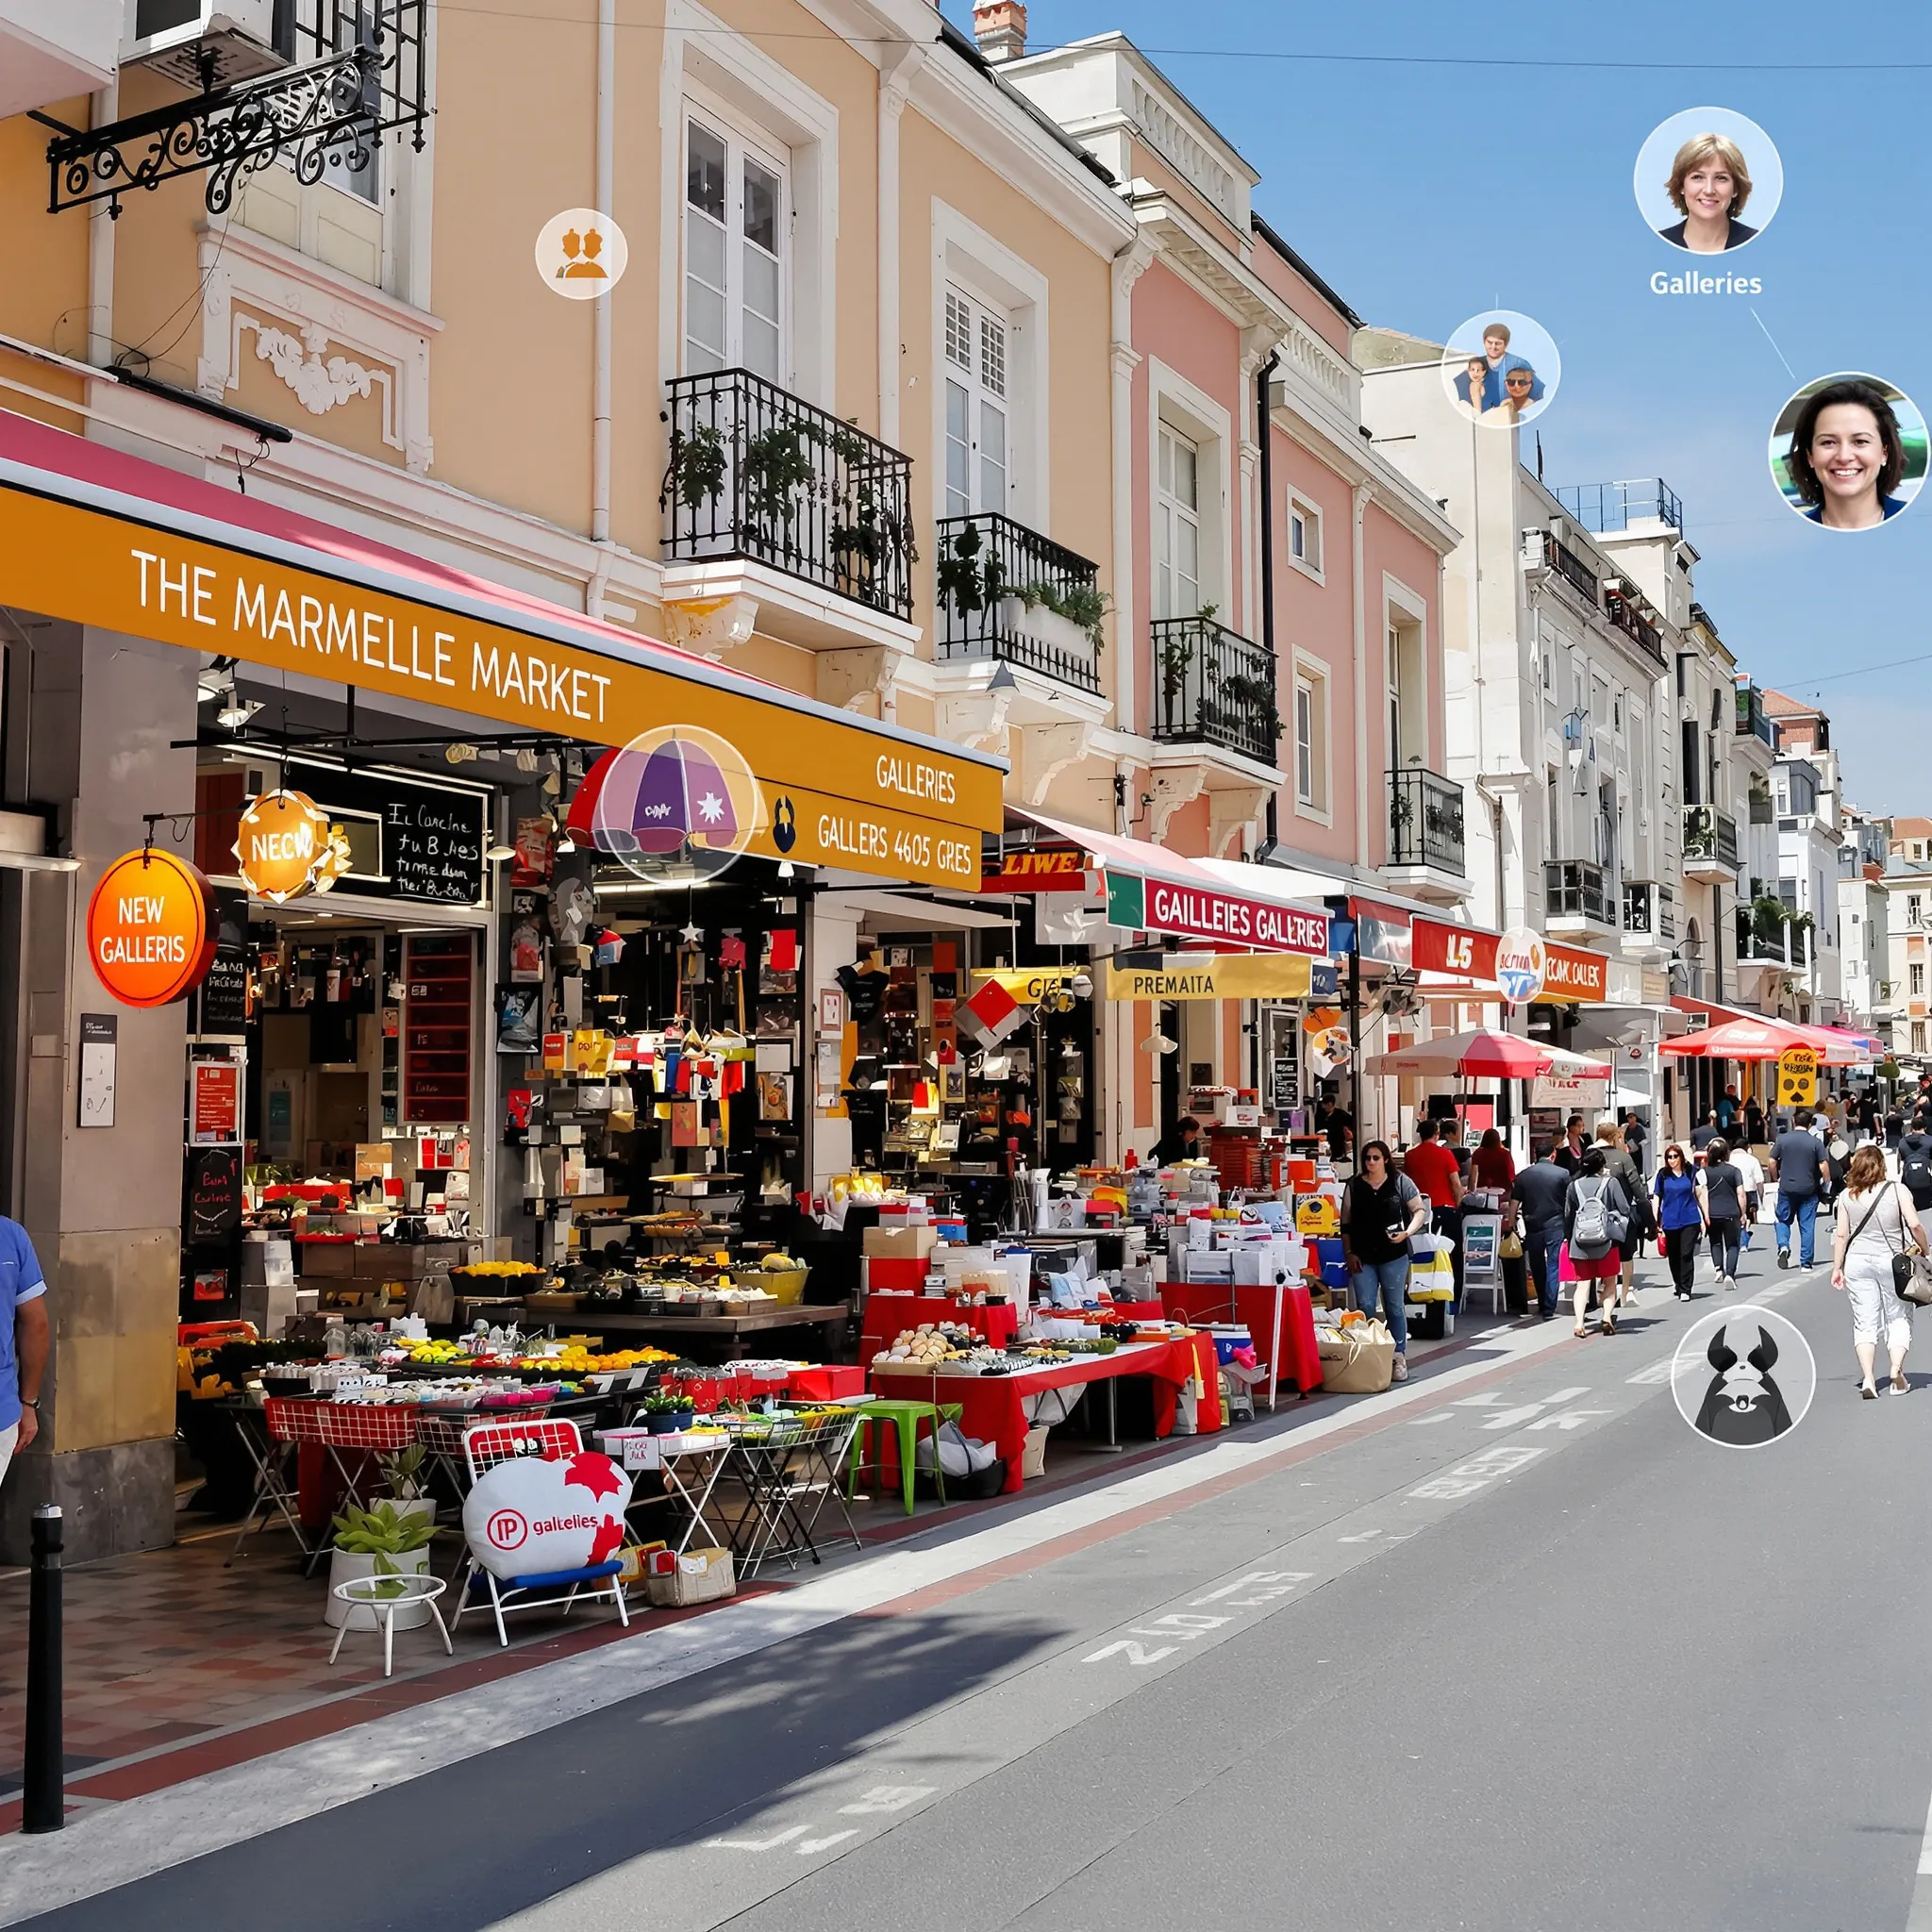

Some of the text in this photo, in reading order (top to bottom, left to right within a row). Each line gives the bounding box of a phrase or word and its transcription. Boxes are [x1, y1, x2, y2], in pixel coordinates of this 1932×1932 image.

[130, 549, 611, 724] THE MARMELLE MARKET
[875, 754, 957, 805] GALLERIES
[818, 814, 888, 858] GALLERS
[118, 896, 165, 924] NEW
[100, 935, 186, 963] GALLERIS
[1134, 974, 1215, 994] PREMAITA
